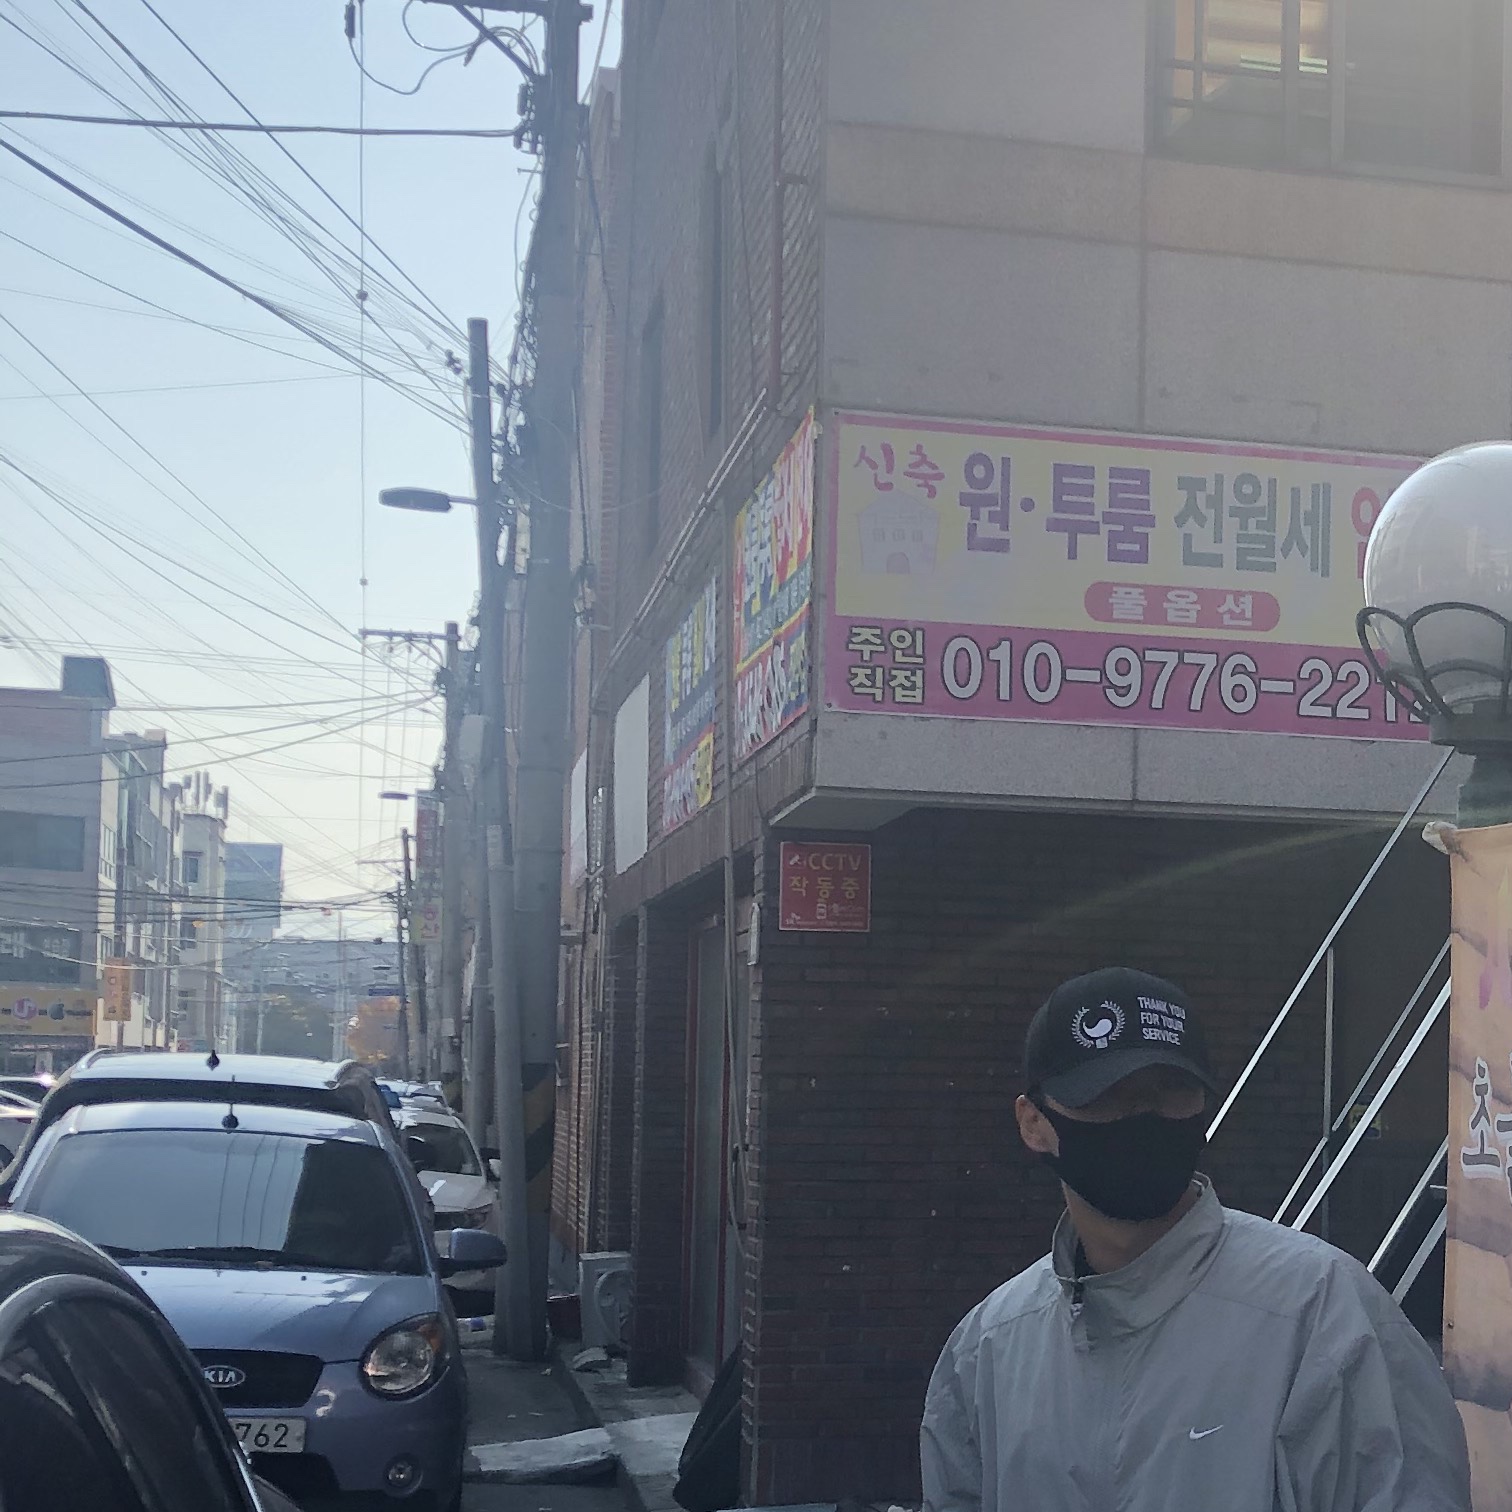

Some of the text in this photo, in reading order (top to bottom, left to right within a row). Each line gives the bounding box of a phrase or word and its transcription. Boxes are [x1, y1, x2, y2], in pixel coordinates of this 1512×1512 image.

[853, 442, 946, 499] 신축
[1174, 472, 1332, 578] 전월세
[848, 625, 925, 664] 주인
[848, 662, 925, 704] 직접
[808, 853, 862, 871] CCTV
[1137, 997, 1186, 1019] THANK YOU
[1141, 1012, 1185, 1032] FOR YOUR
[1143, 1028, 1181, 1045] SERVICE
[204, 1369, 237, 1384] KIA
